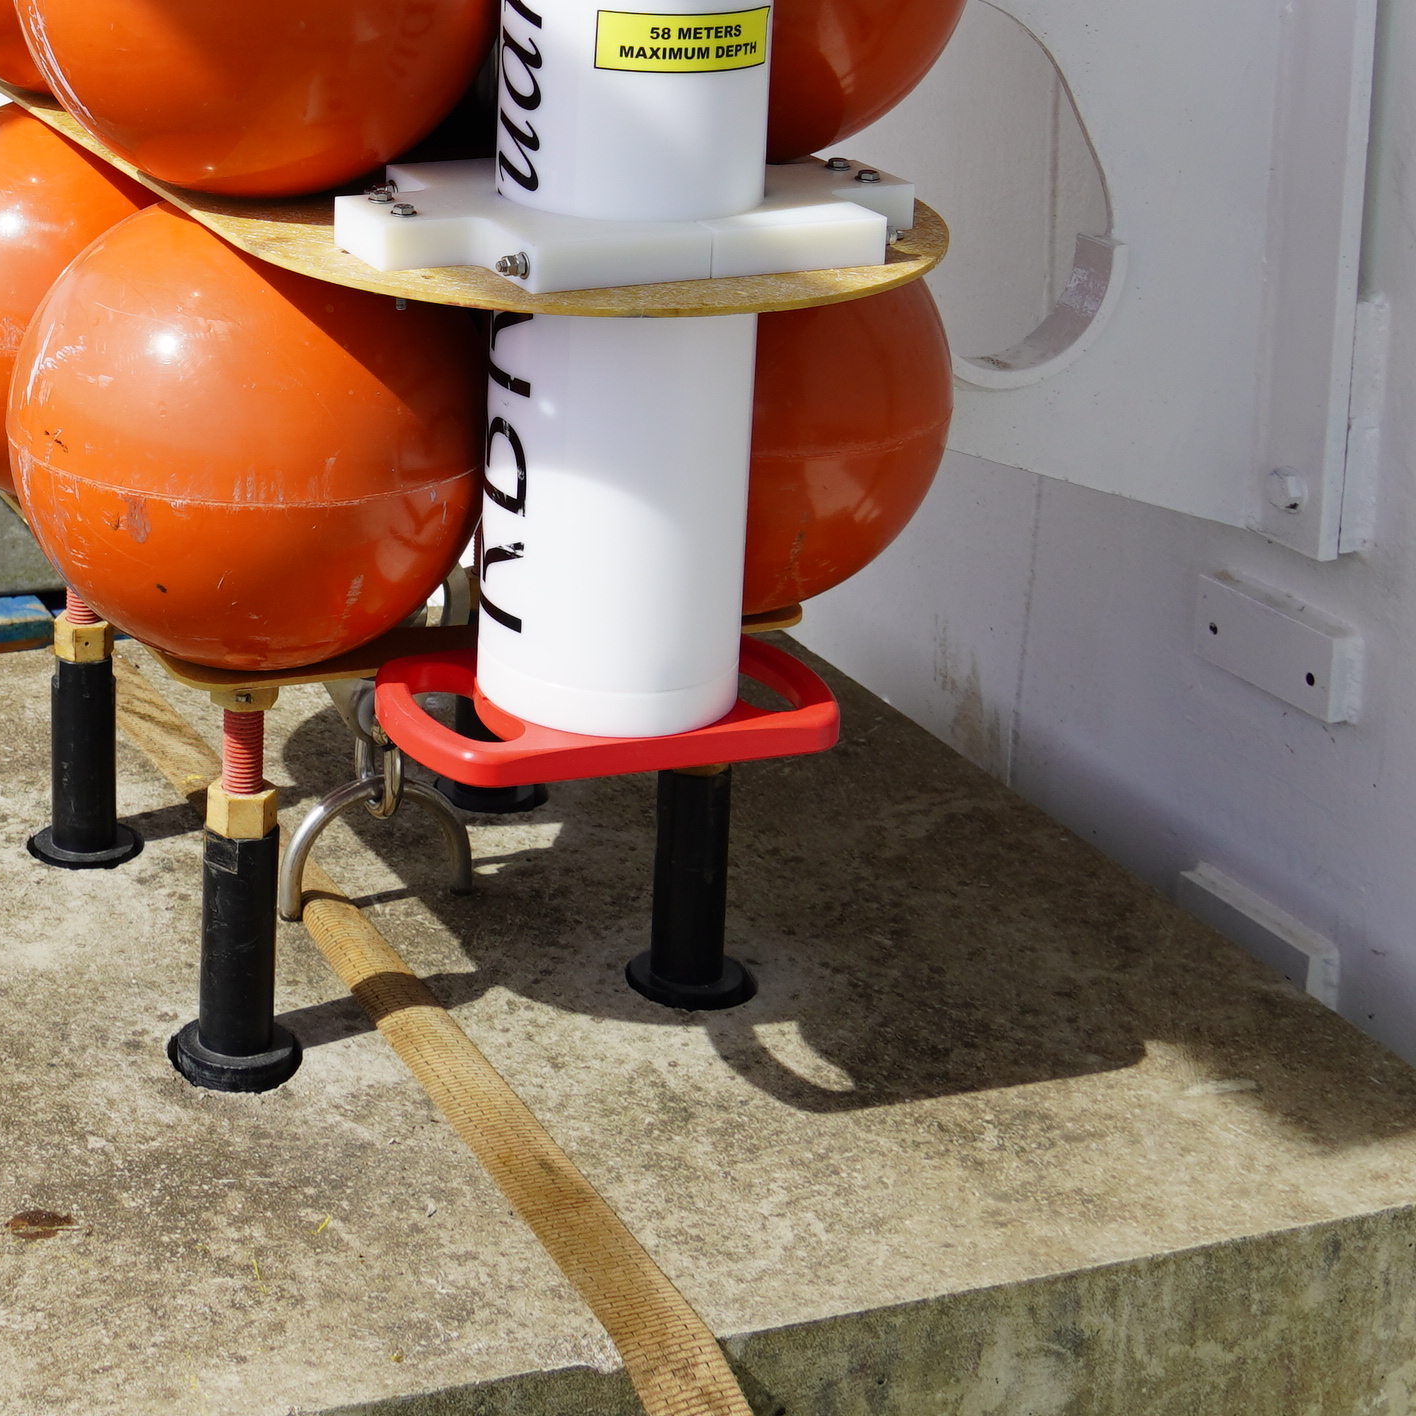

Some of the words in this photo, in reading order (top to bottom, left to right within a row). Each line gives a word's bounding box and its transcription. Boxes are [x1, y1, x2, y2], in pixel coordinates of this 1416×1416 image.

[650, 27, 671, 40] 58
[677, 25, 742, 40] METERS
[619, 45, 710, 60] MAXIMUM
[715, 41, 757, 59] DEPTH
